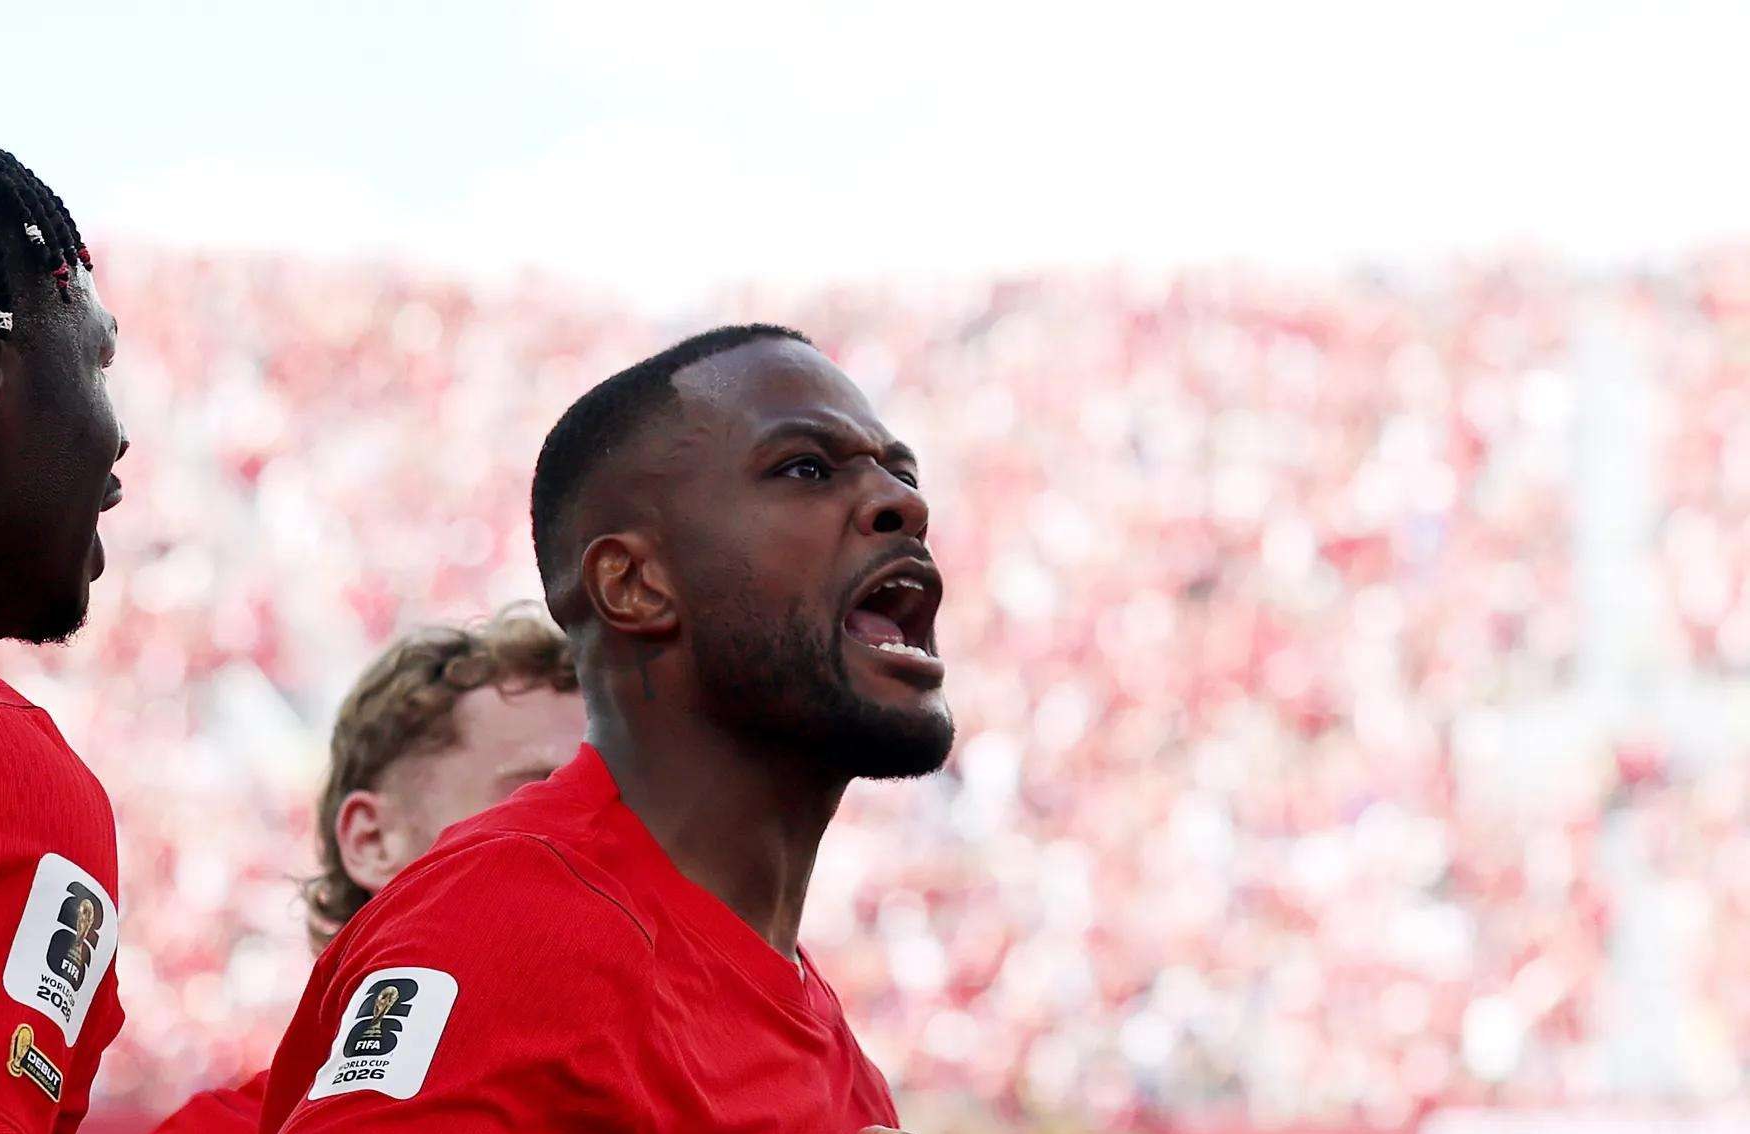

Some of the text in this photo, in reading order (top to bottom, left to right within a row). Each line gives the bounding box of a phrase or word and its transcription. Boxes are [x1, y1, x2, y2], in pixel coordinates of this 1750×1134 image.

[60, 958, 80, 982] FIFA
[355, 1040, 381, 1051] FIFA
[27, 1050, 61, 1086] DEBUT
[369, 1059, 390, 1068] CUP
[331, 1068, 386, 1085] 2026
